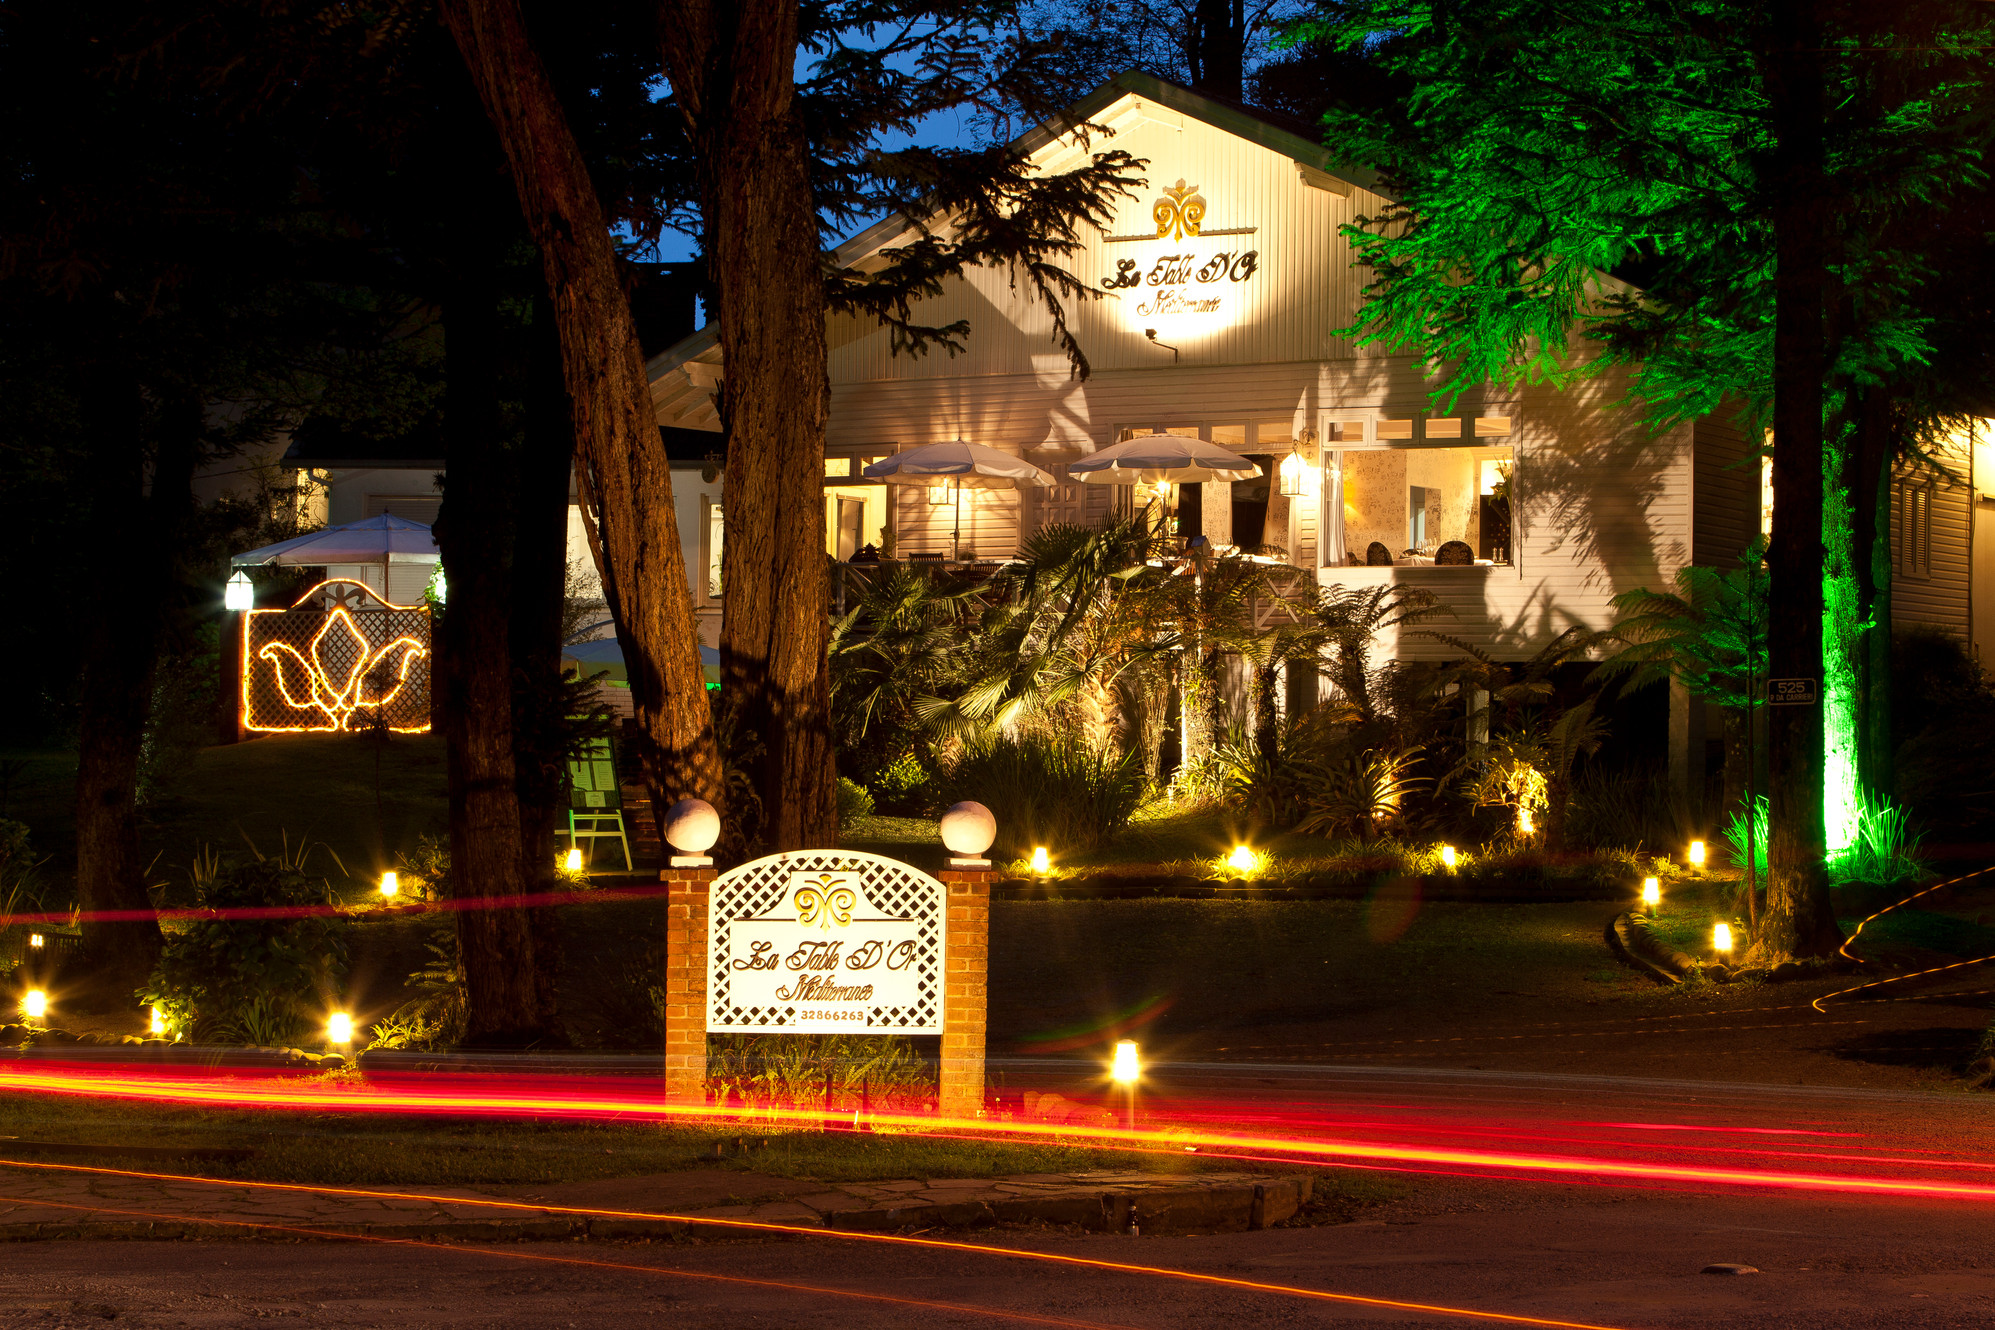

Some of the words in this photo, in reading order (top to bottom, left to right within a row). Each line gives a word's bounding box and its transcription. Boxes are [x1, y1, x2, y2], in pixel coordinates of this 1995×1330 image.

[1100, 258, 1142, 290] La
[1146, 253, 1196, 287] Table
[1778, 681, 1805, 693] 525
[732, 940, 780, 971] La
[785, 940, 845, 971] Table
[845, 939, 917, 971] D'Or
[800, 1010, 864, 1021] 32866263
